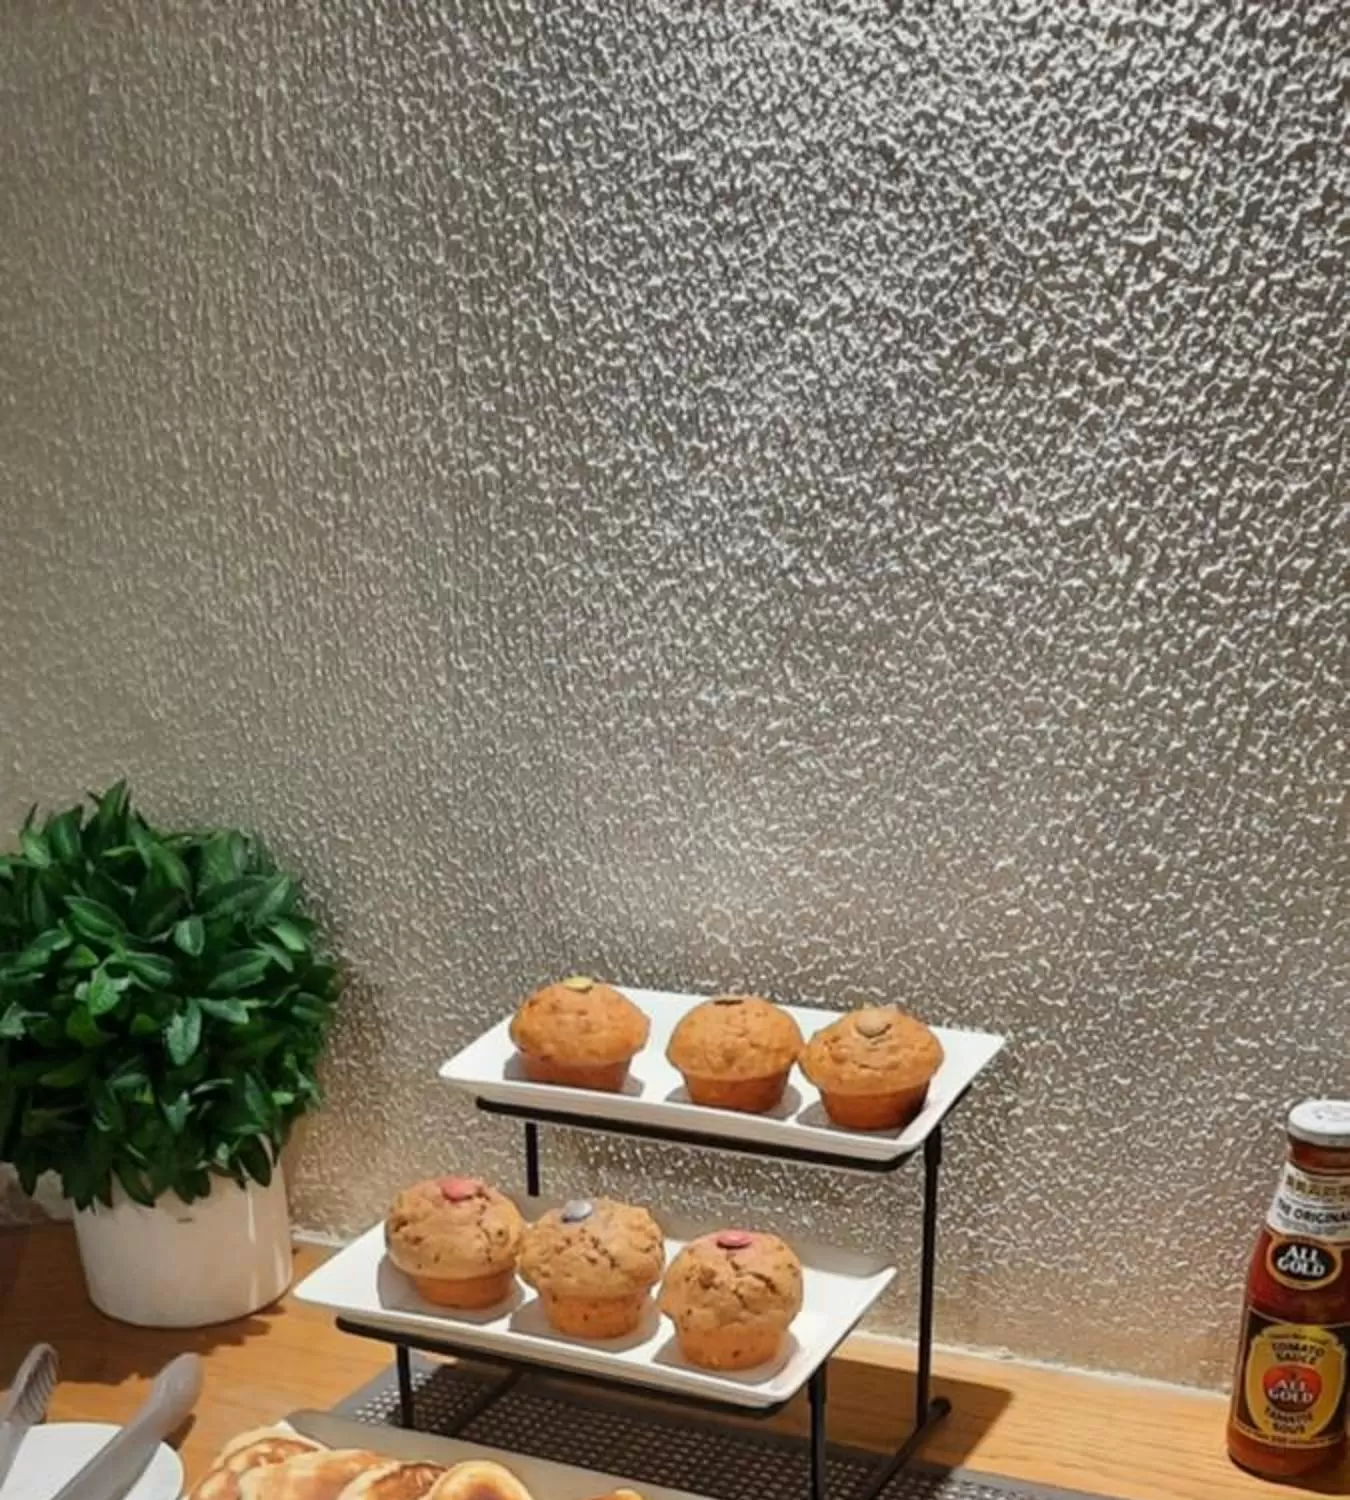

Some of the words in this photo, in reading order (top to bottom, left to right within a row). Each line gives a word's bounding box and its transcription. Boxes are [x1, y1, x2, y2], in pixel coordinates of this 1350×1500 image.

[1294, 1208, 1350, 1224] ORIGINA
[1287, 1245, 1319, 1261] ALL
[1277, 1255, 1325, 1277] GOLD
[1271, 1342, 1326, 1357] TOMATO
[1276, 1379, 1308, 1390] ALL
[1268, 1387, 1314, 1404] GOLD
